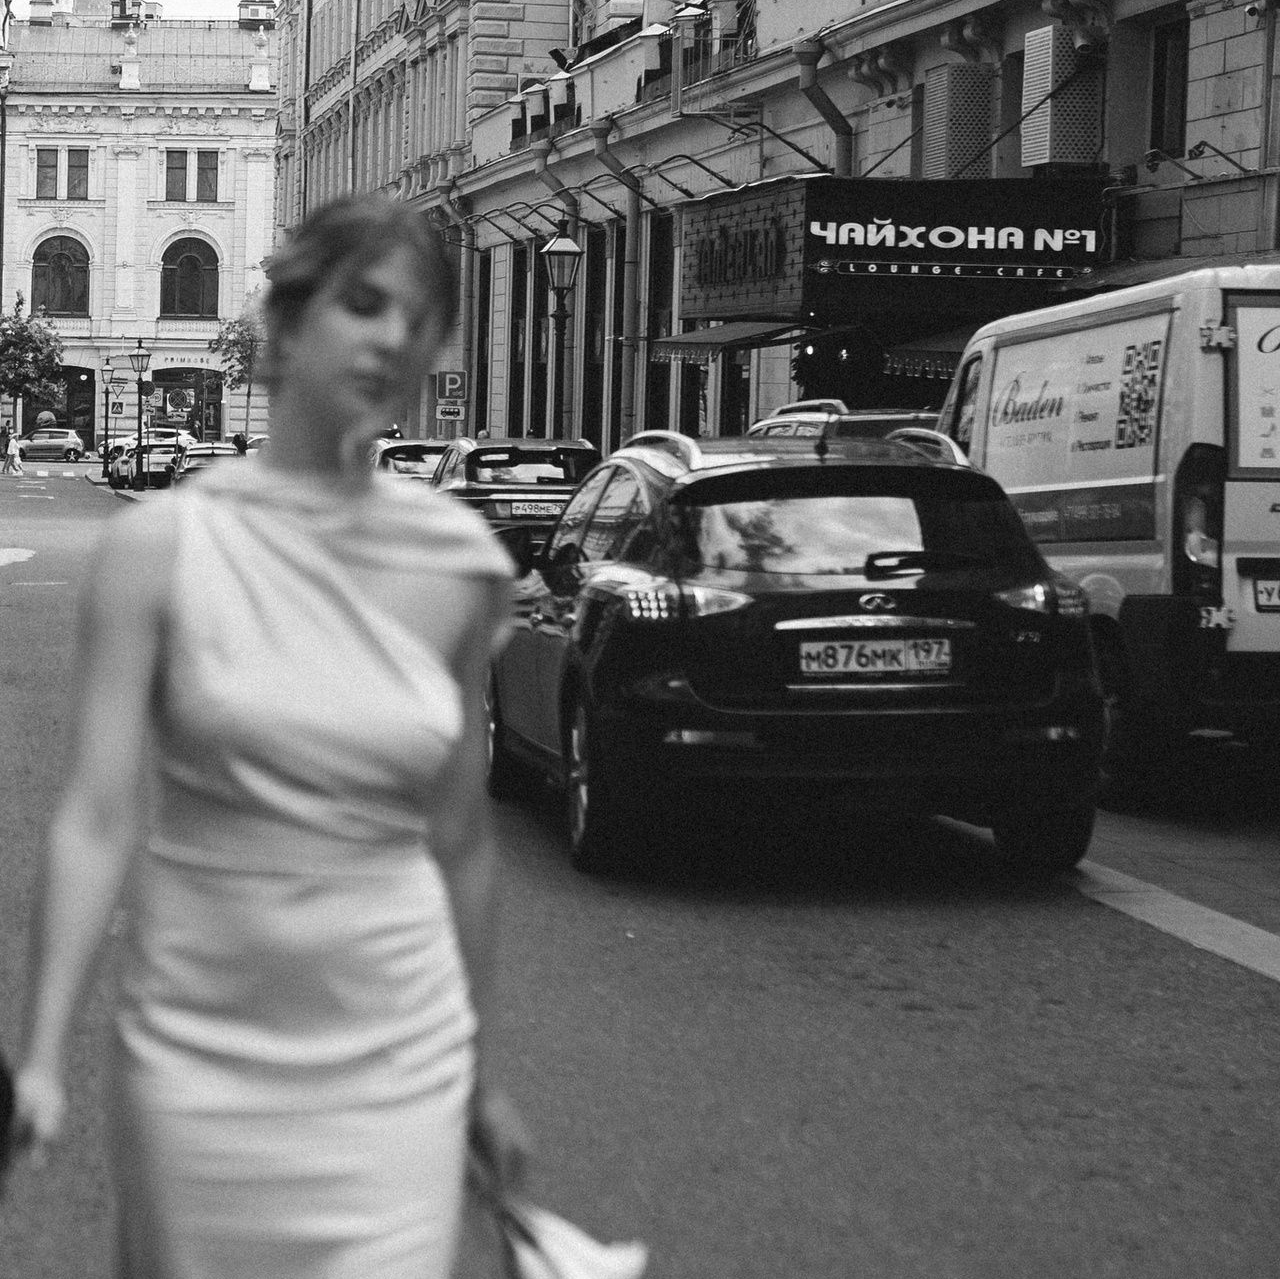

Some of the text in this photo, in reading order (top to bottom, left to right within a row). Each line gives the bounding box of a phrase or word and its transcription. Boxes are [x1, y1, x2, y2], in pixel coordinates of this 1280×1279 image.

[810, 217, 1024, 250] ЧАЙХОНА
[445, 373, 462, 397] P
[992, 372, 1063, 427] Baden
[805, 639, 945, 669] М876МК 197
